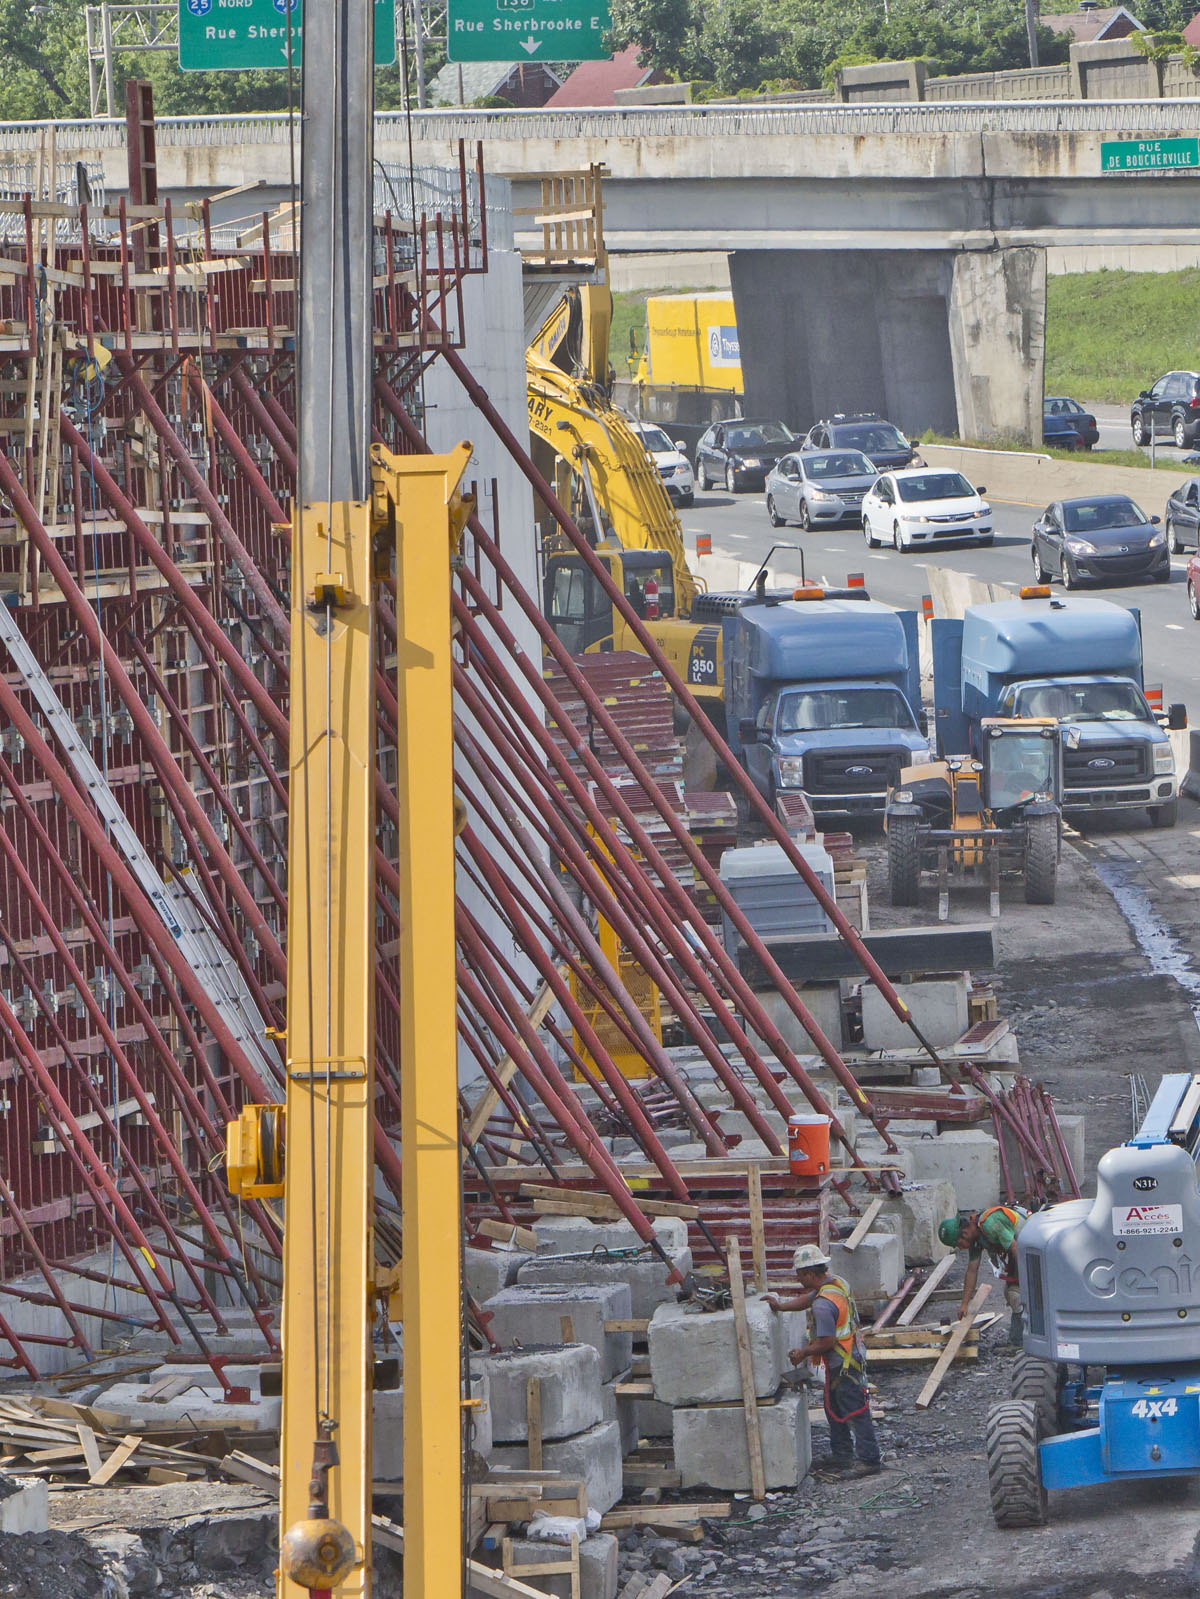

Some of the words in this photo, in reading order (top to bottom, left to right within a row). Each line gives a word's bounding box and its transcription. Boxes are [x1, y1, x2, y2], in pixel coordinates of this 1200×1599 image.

[190, 0, 209, 9] 25
[218, 0, 254, 8] NORD
[454, 19, 484, 32] Rue
[493, 18, 583, 31] Sherbrooke
[205, 26, 236, 39] Rue
[1138, 142, 1161, 152] RUE
[1109, 156, 1121, 168] DE
[1126, 152, 1191, 167] BOUCHERVILLE
[692, 659, 714, 673] 350
[692, 672, 702, 682] LC
[1134, 1179, 1158, 1189] N314
[1131, 1397, 1178, 1418] 4x4
